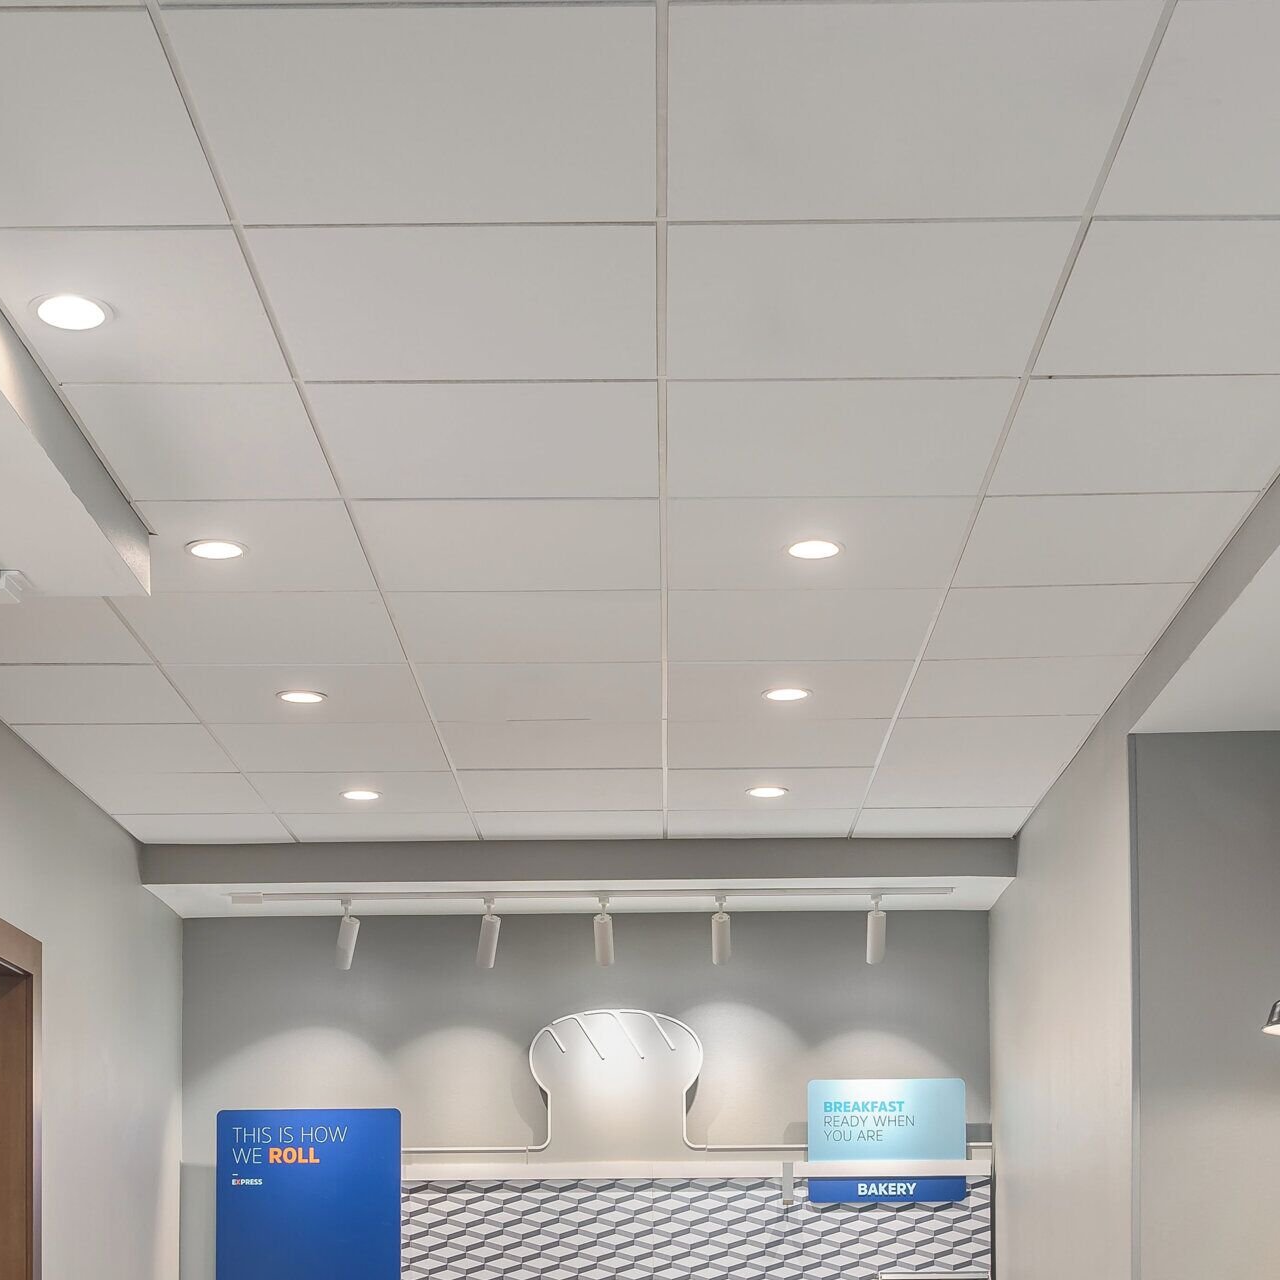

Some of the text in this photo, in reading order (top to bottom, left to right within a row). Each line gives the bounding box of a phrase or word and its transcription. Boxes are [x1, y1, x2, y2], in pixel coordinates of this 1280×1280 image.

[823, 1100, 905, 1113] BREAKFAST
[823, 1114, 916, 1128] READY WHEN
[232, 1126, 348, 1144] THIS IS HOW
[823, 1129, 884, 1142] YOU ARE
[232, 1147, 320, 1165] WE ROLL
[231, 1178, 263, 1186] EXPRESS
[857, 1182, 917, 1197] BAKERY
